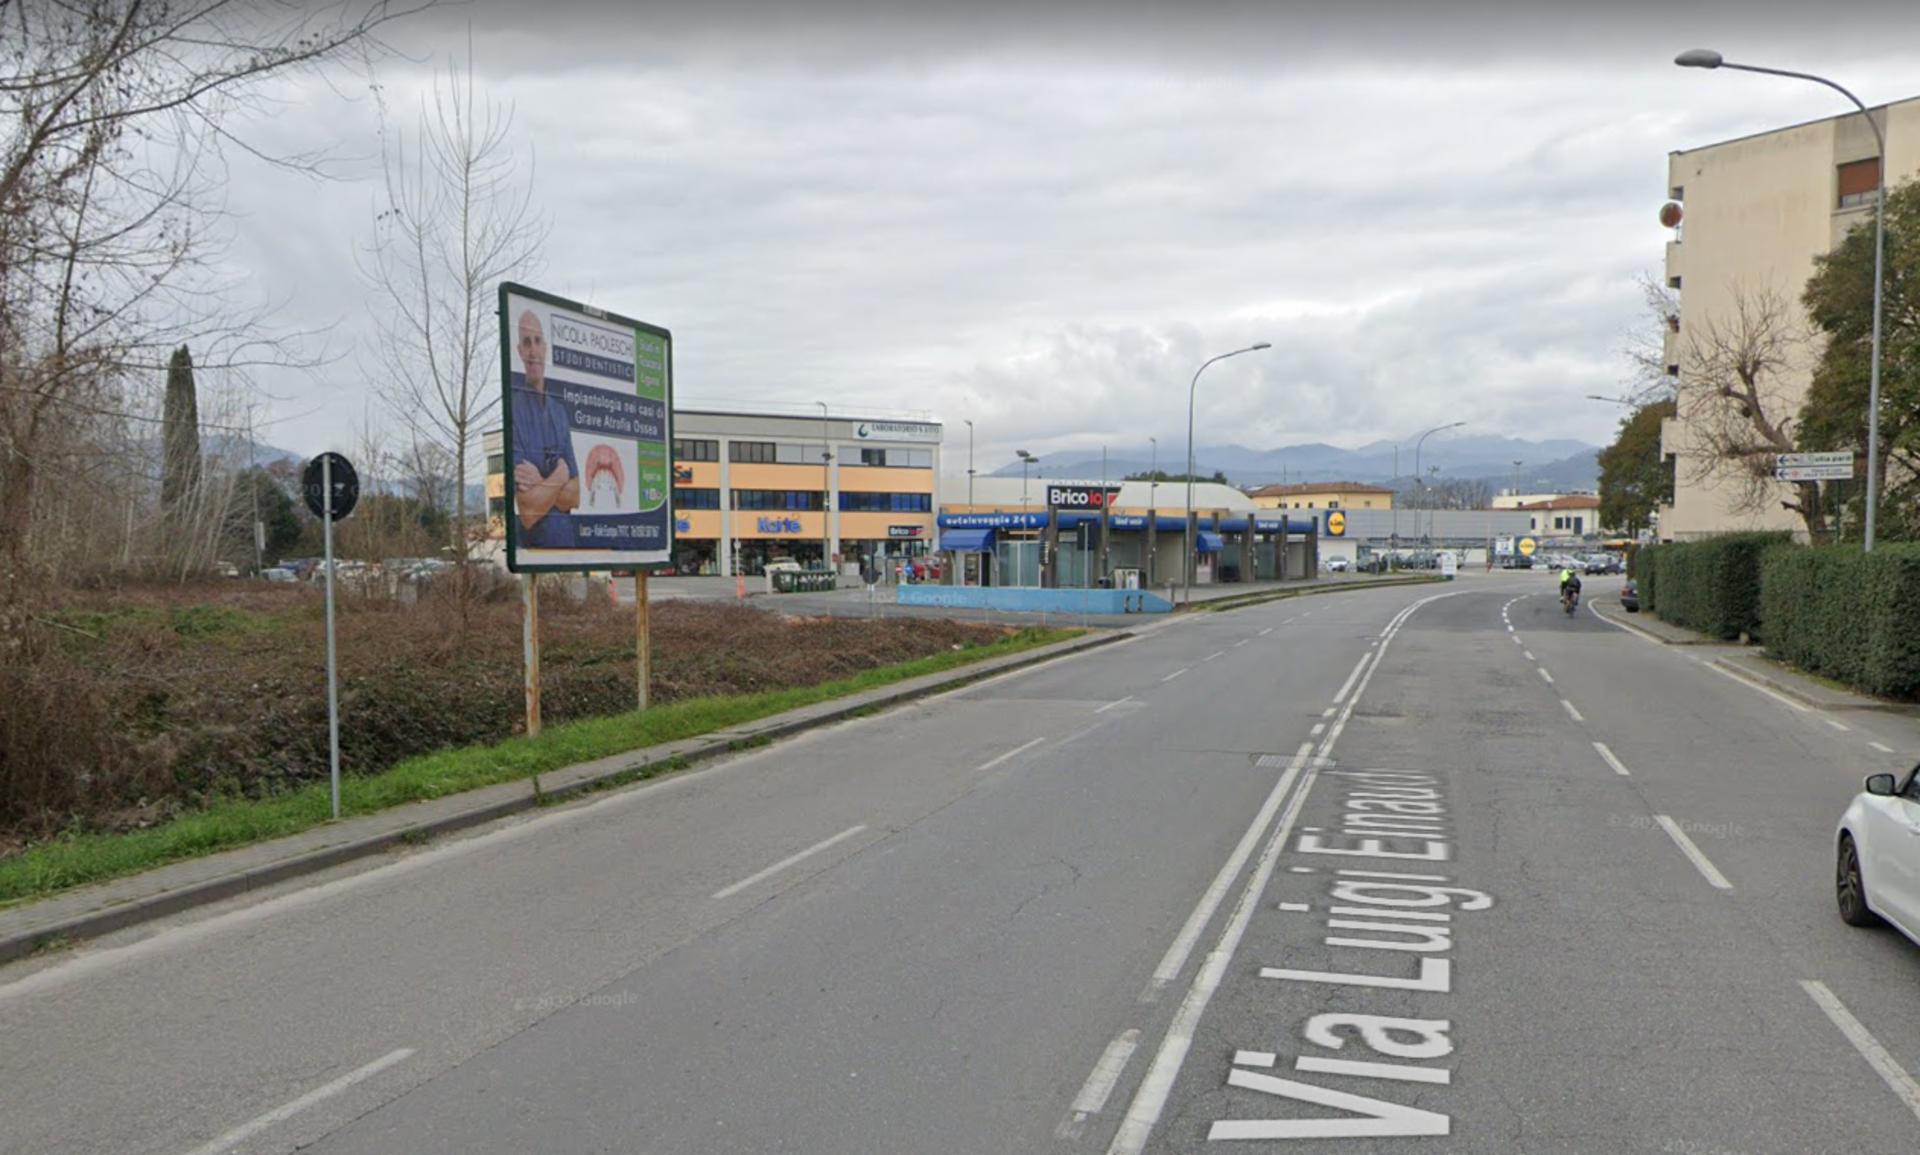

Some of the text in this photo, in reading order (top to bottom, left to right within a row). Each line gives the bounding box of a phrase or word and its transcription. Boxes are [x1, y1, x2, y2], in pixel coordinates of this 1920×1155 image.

[552, 323, 588, 346] NICOLA
[554, 349, 583, 368] STUDI
[563, 387, 622, 412] Impiantologia
[575, 410, 602, 427] Grave
[633, 419, 658, 435] Ossea
